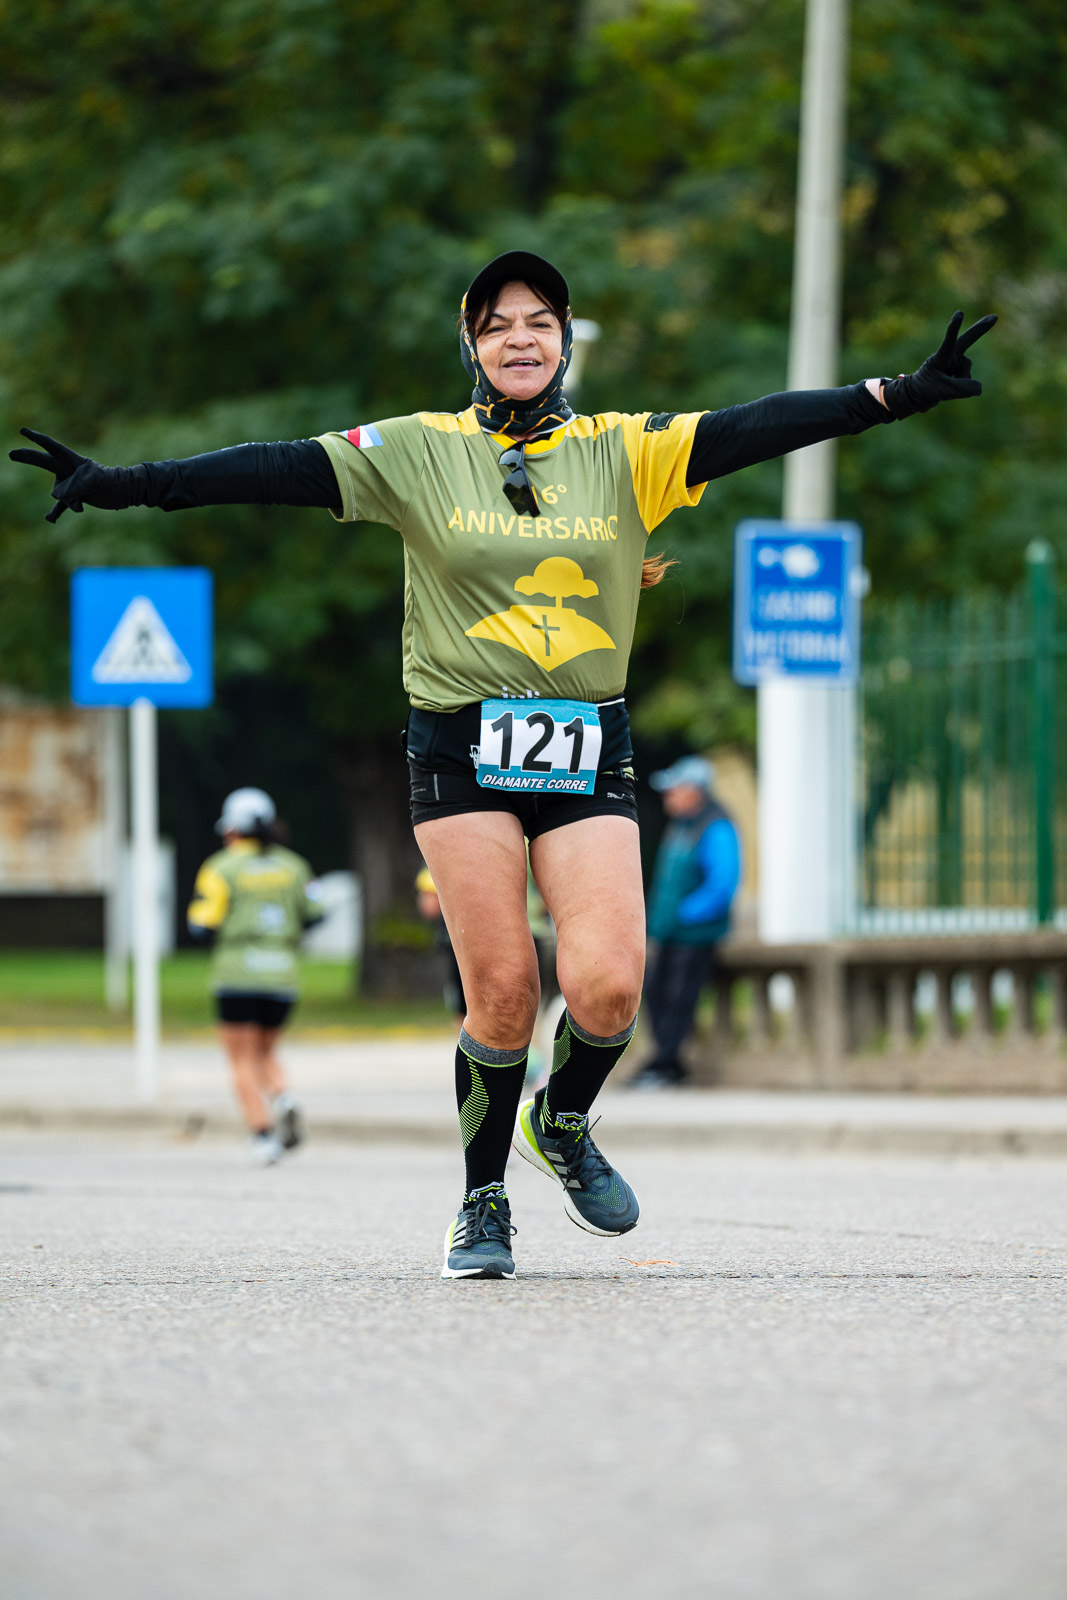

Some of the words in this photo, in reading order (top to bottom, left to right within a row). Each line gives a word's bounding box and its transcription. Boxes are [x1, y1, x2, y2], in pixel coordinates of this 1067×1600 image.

[448, 506, 618, 541] ANIVERSARIO
[490, 710, 586, 775] 121
[482, 774, 546, 789] DIAMANTE
[547, 779, 589, 791] CORRE
